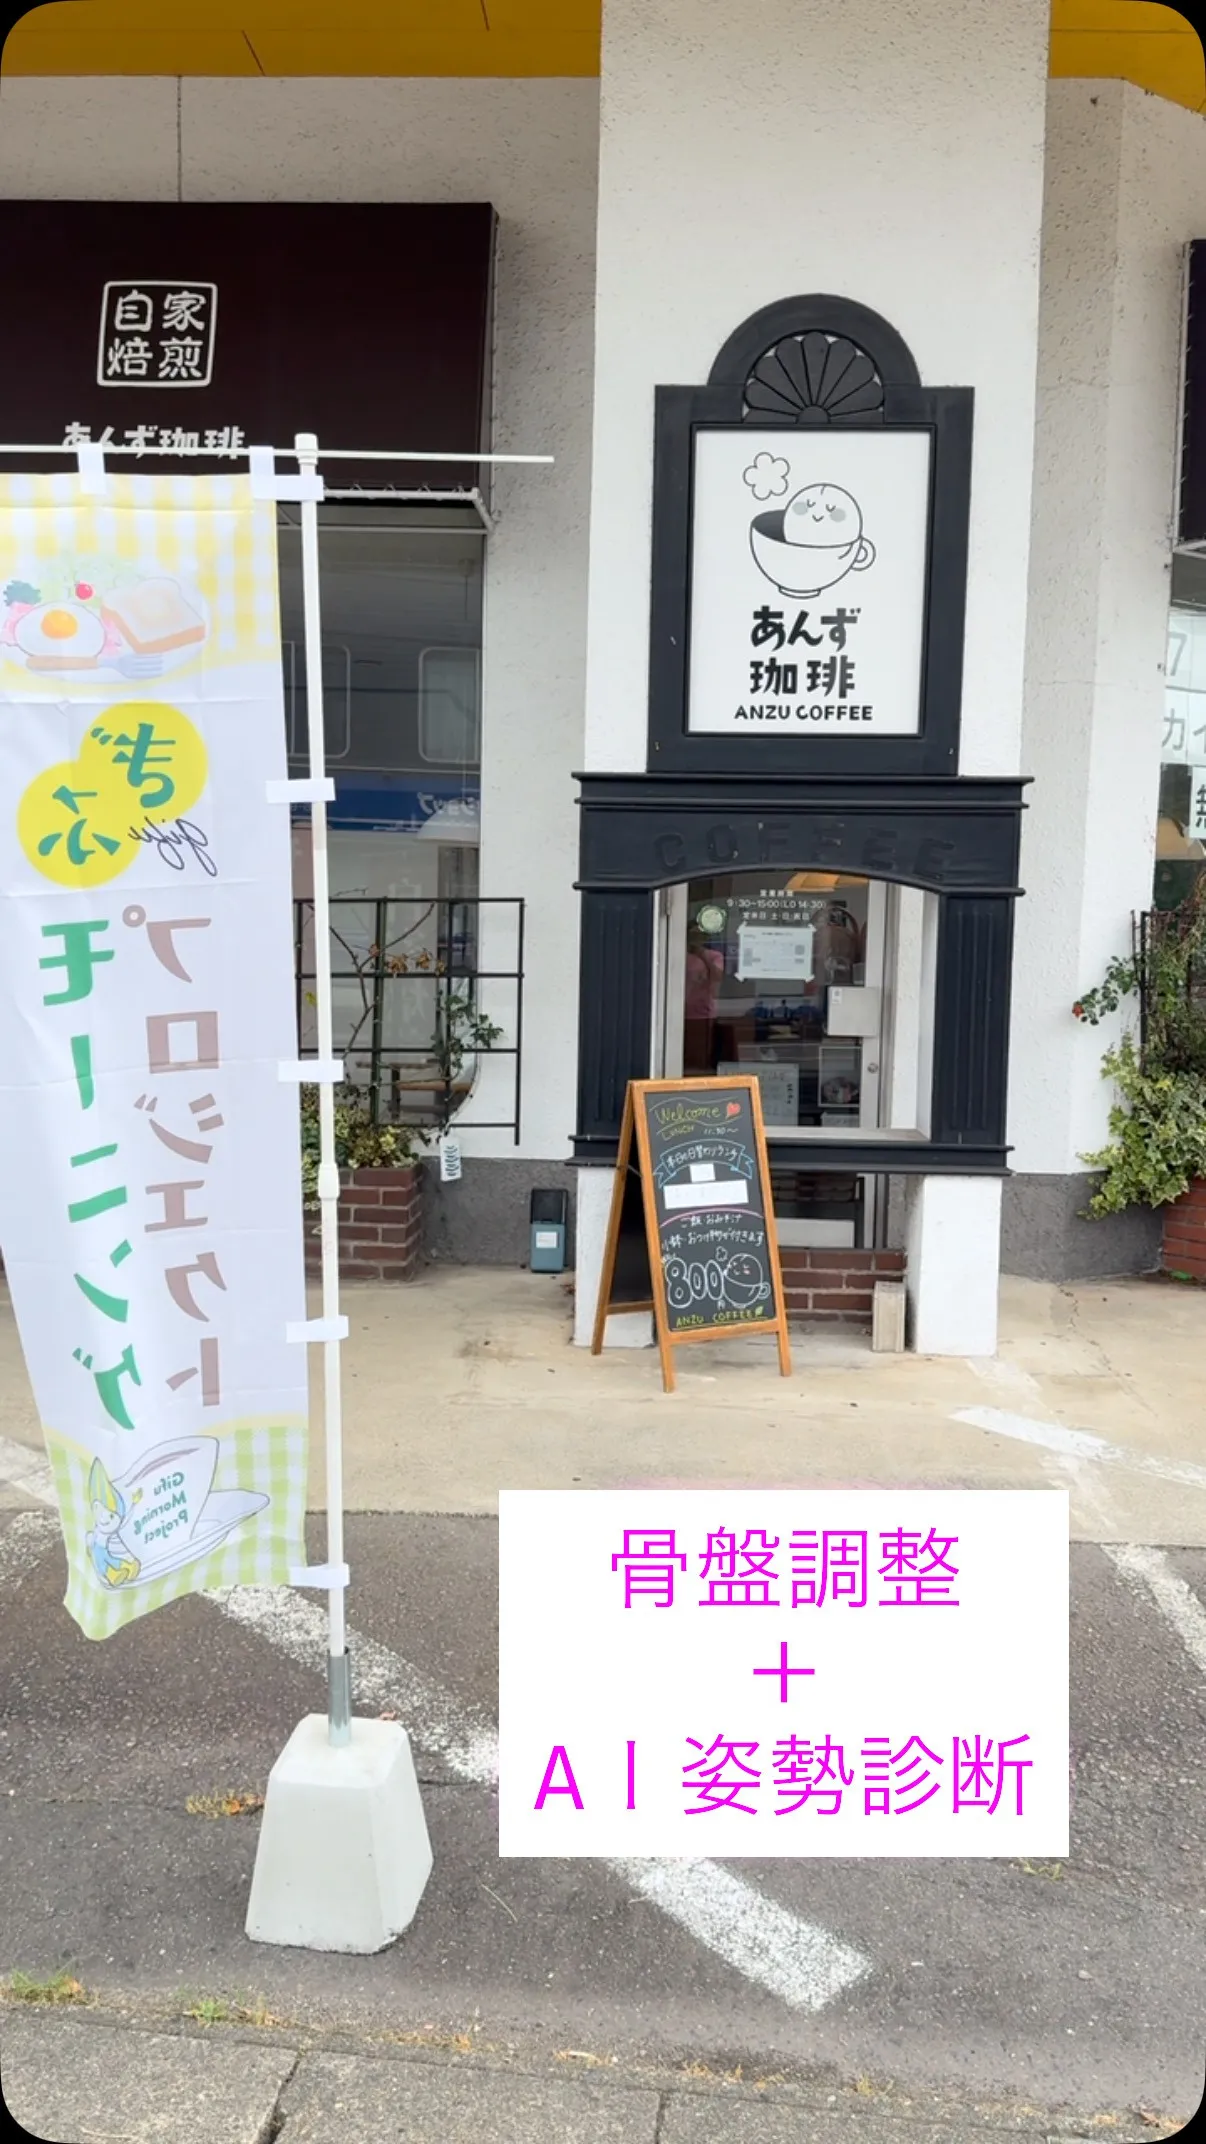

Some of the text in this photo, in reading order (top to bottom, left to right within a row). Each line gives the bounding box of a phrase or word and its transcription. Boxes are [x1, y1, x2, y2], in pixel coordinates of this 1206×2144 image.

[114, 289, 207, 333] 自家
[106, 336, 204, 378] 焙煎
[749, 605, 862, 653] あんず
[749, 655, 856, 699] 珈琲
[734, 704, 873, 722] ANZU COFFEE
[653, 820, 956, 880] COFFEE
[654, 1102, 721, 1125] Welcome
[664, 1257, 724, 1309] 800
[676, 1308, 754, 1328] ANZU COFFEE
